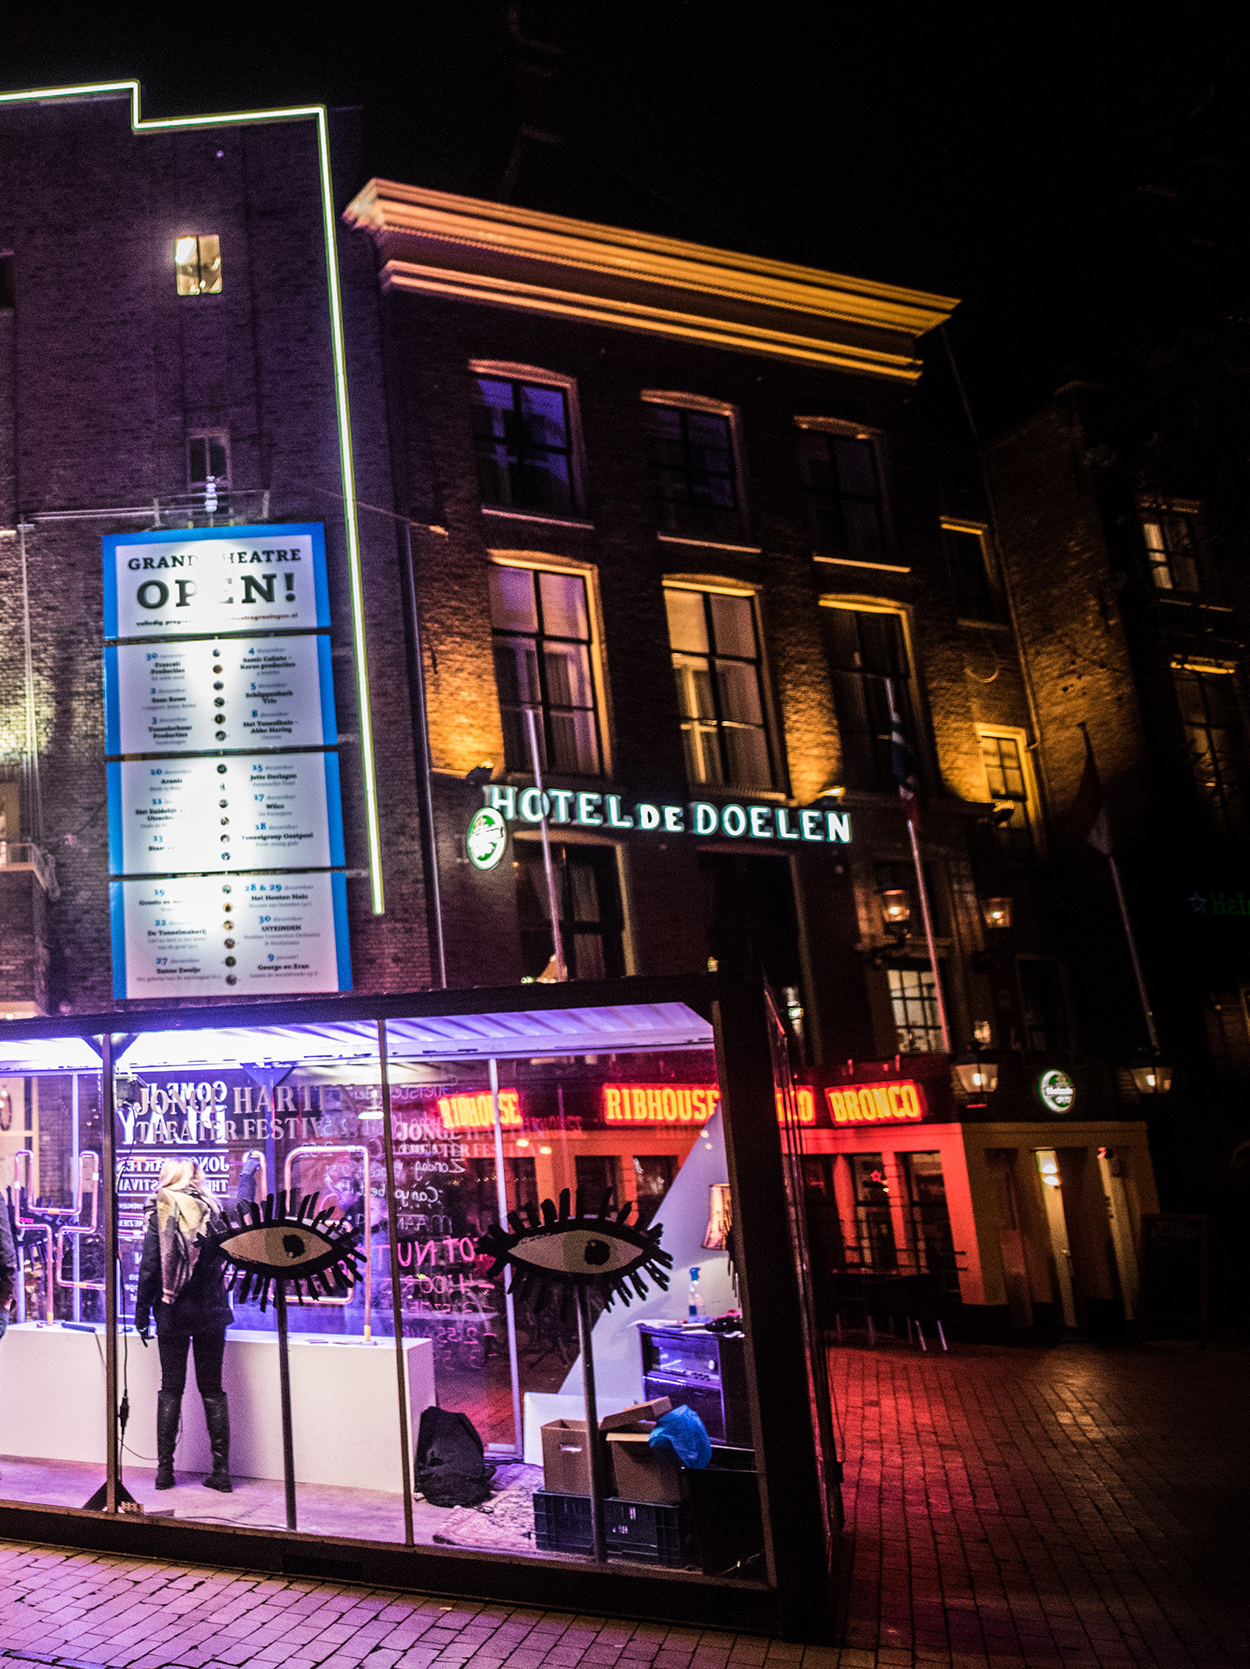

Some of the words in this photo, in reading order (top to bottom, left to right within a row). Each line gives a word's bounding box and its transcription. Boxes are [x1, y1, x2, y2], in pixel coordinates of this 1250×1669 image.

[222, 549, 301, 564] HEATRE
[486, 785, 635, 829] HOTEL
[637, 803, 685, 832] DE
[693, 802, 853, 844] DOELEN
[270, 884, 282, 892] 29
[259, 916, 271, 924] 30
[139, 1088, 222, 1115] JONGE
[438, 1094, 522, 1128] RIBHOUSE
[604, 1088, 719, 1121] RIBHOUSE
[828, 1085, 919, 1122] BRONCO
